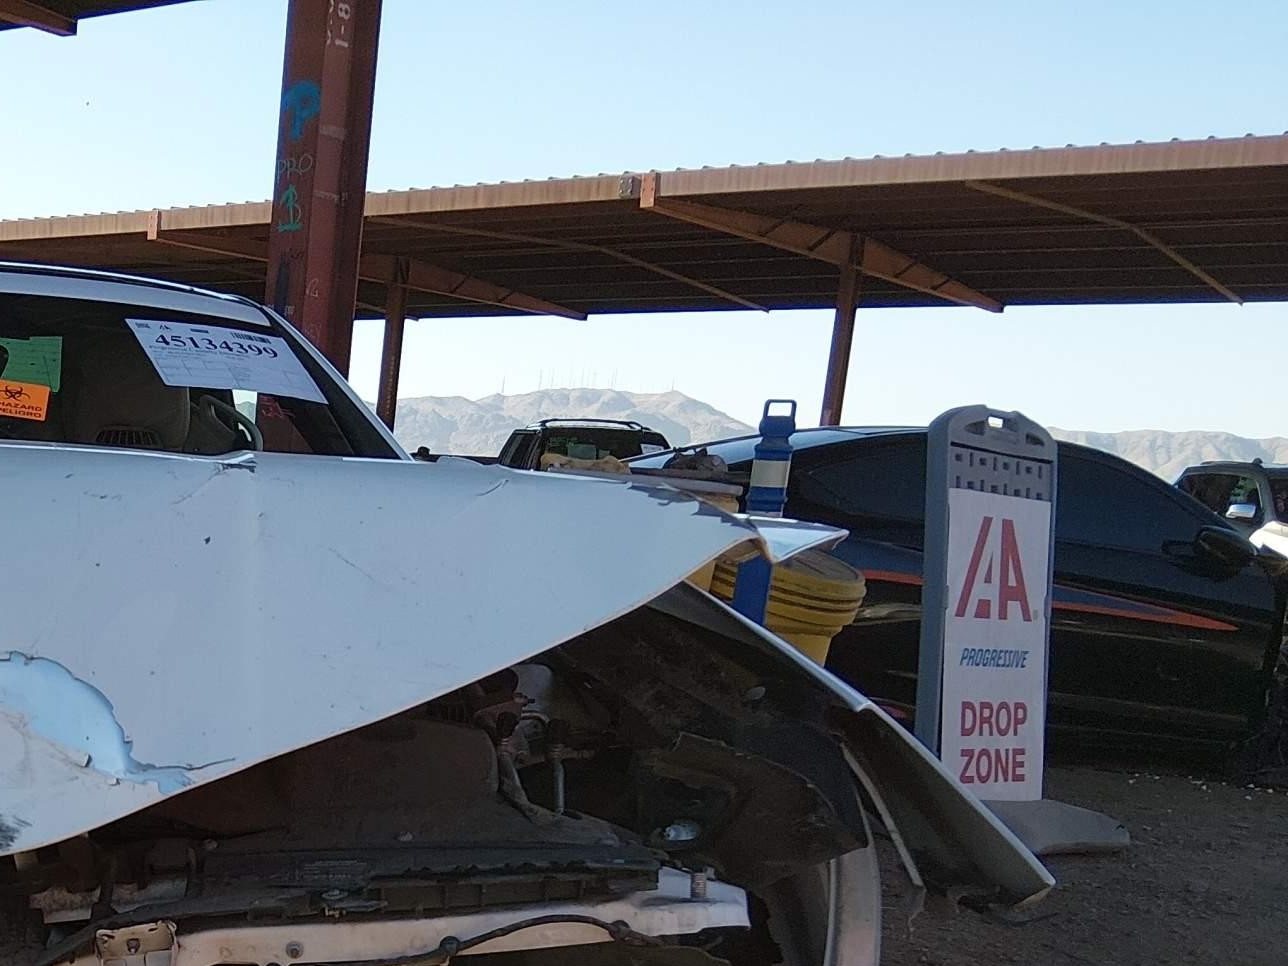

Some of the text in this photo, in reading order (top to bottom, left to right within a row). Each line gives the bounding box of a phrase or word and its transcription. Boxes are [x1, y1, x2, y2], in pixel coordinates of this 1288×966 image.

[155, 334, 278, 359] 45134399
[960, 648, 1029, 669] PROGRESSIVE
[960, 701, 1028, 737] DROP
[959, 748, 1026, 784] ZONE
